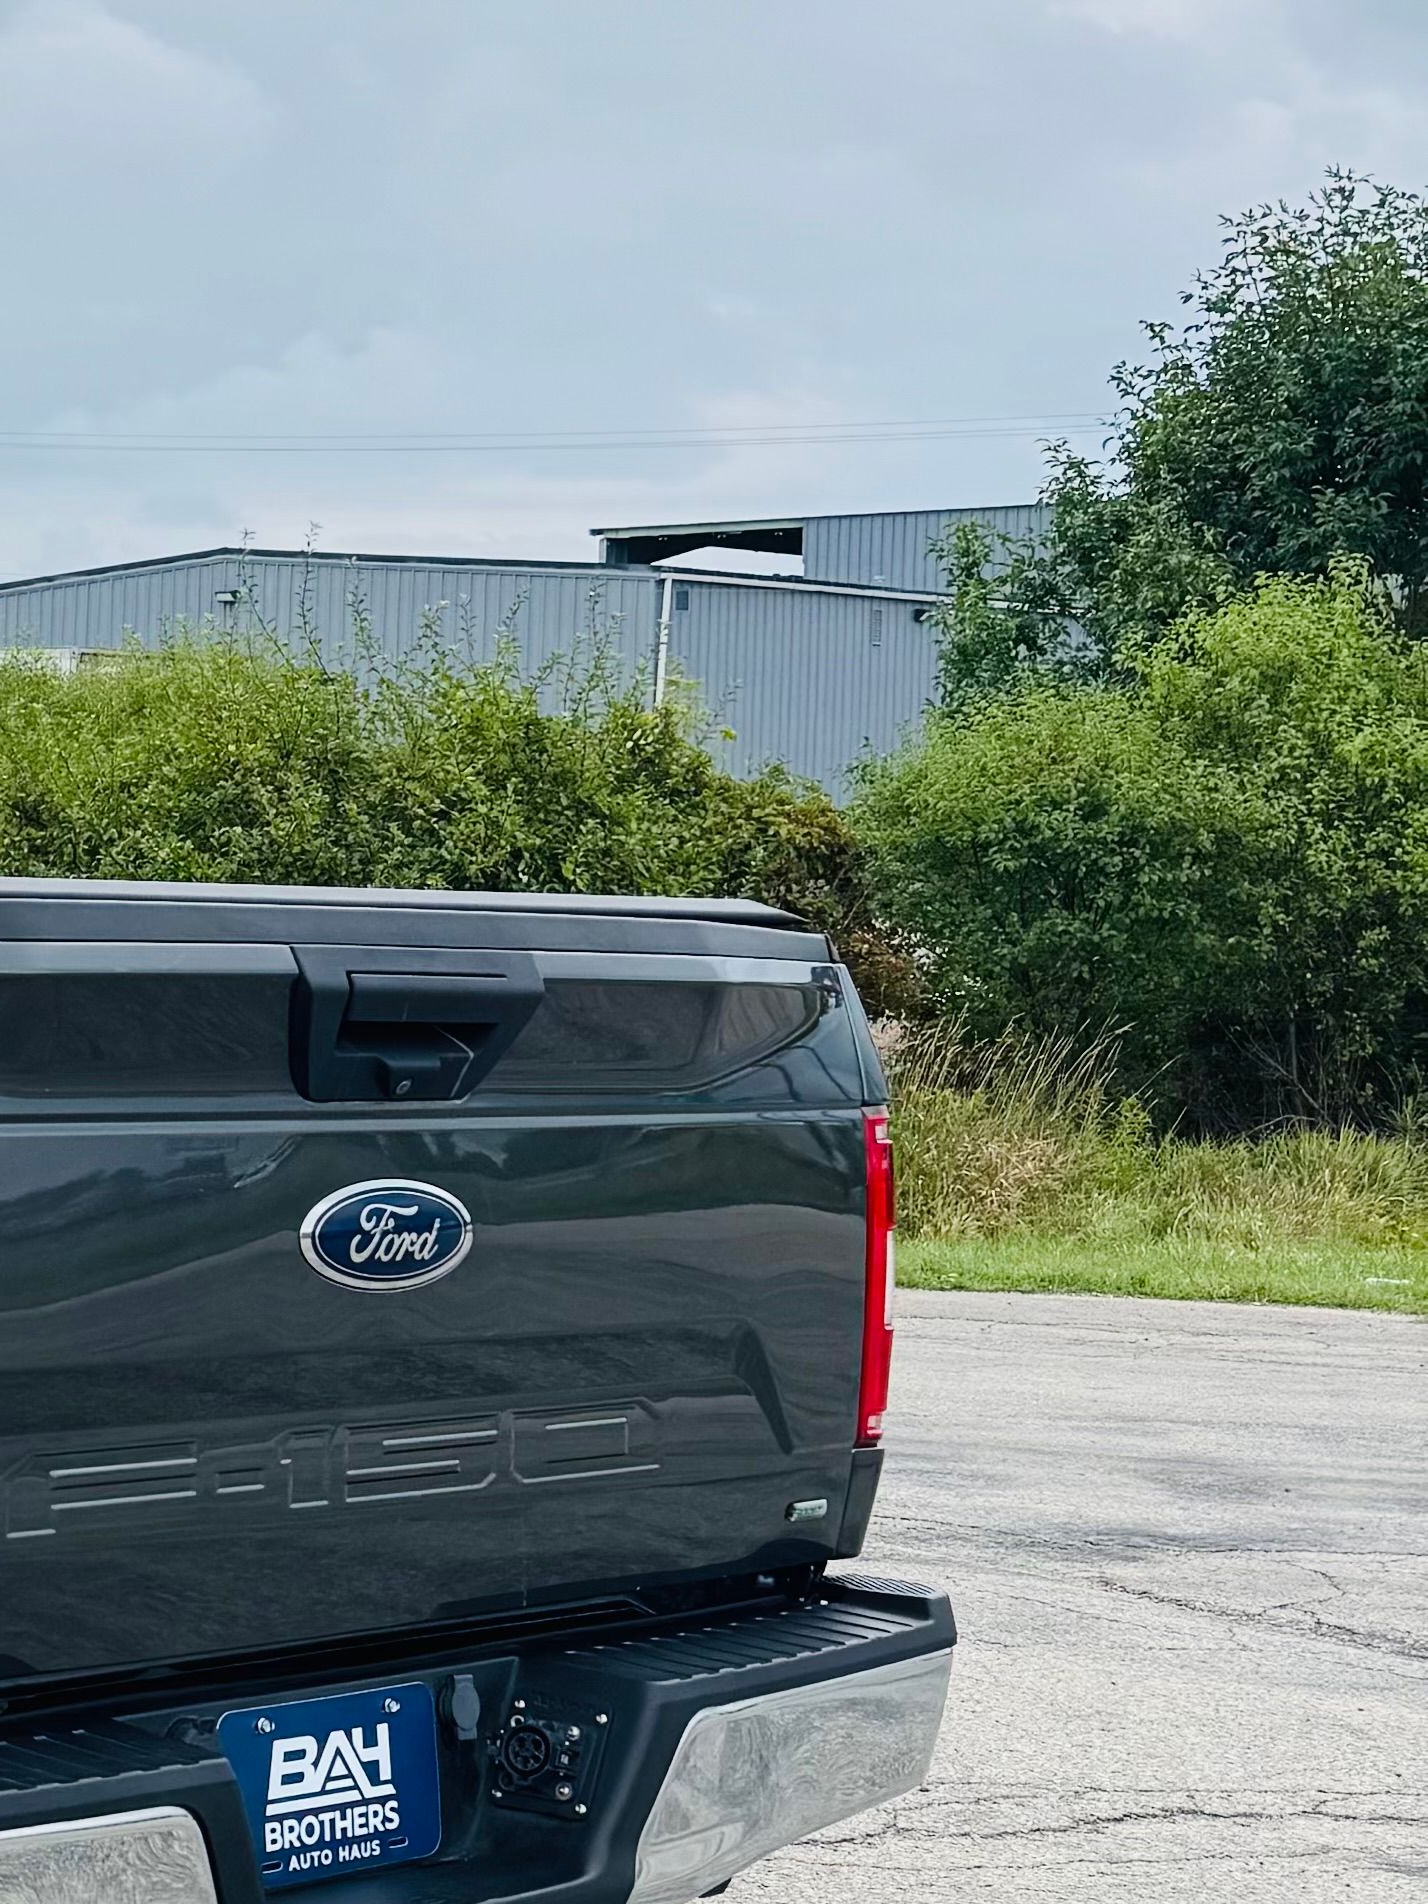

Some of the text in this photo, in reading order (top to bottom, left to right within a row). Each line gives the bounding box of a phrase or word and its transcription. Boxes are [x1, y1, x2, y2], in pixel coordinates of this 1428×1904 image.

[349, 1203, 442, 1264] Ford
[5, 1397, 662, 1539] F-150
[264, 1800, 401, 1853] BROTHERS
[288, 1839, 382, 1872] AUTO HAUS
